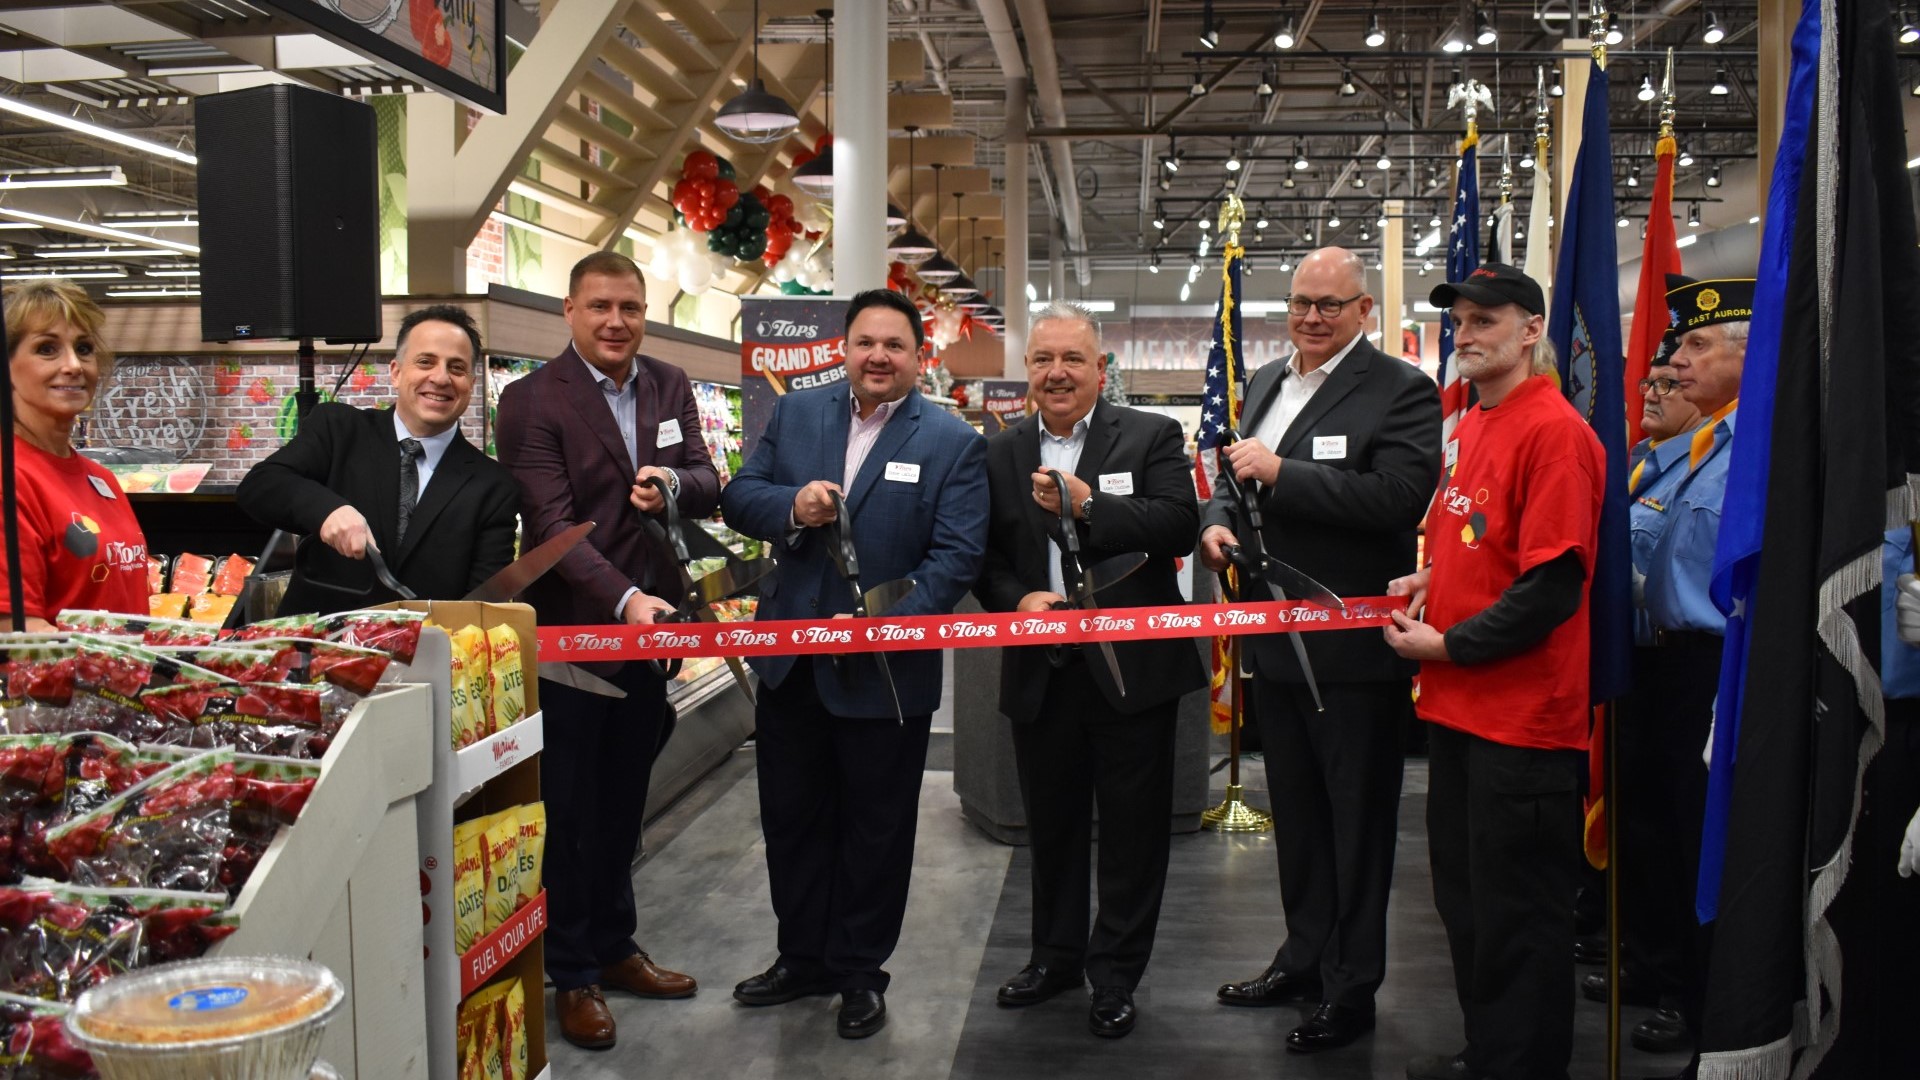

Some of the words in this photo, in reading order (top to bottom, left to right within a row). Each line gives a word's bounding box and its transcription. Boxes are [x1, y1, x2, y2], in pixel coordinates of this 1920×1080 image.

[771, 319, 819, 339] TOPS
[1688, 313, 1710, 326] EAST
[1714, 308, 1753, 319] AURORA
[751, 346, 811, 372] GRAND
[1124, 340, 1189, 370] MEAT
[102, 366, 197, 438] Fresh
[986, 399, 1013, 412] GRAND
[113, 541, 146, 563] TOPS
[574, 633, 623, 650] TOPS
[652, 631, 701, 648] TOPS
[730, 629, 778, 646] TOPS
[806, 626, 852, 643] TOPS
[880, 624, 926, 641] TOPS
[953, 621, 997, 638] TOPS
[1023, 618, 1067, 635] TOPS
[1093, 615, 1135, 632] TOPS
[1160, 612, 1202, 628] TOPS
[1226, 609, 1267, 625] TOPS
[1290, 607, 1330, 622] TOPS
[458, 888, 484, 918] DATES
[472, 946, 498, 980] FUEL
[498, 922, 526, 958] YOUR
[526, 906, 544, 935] LIFE
